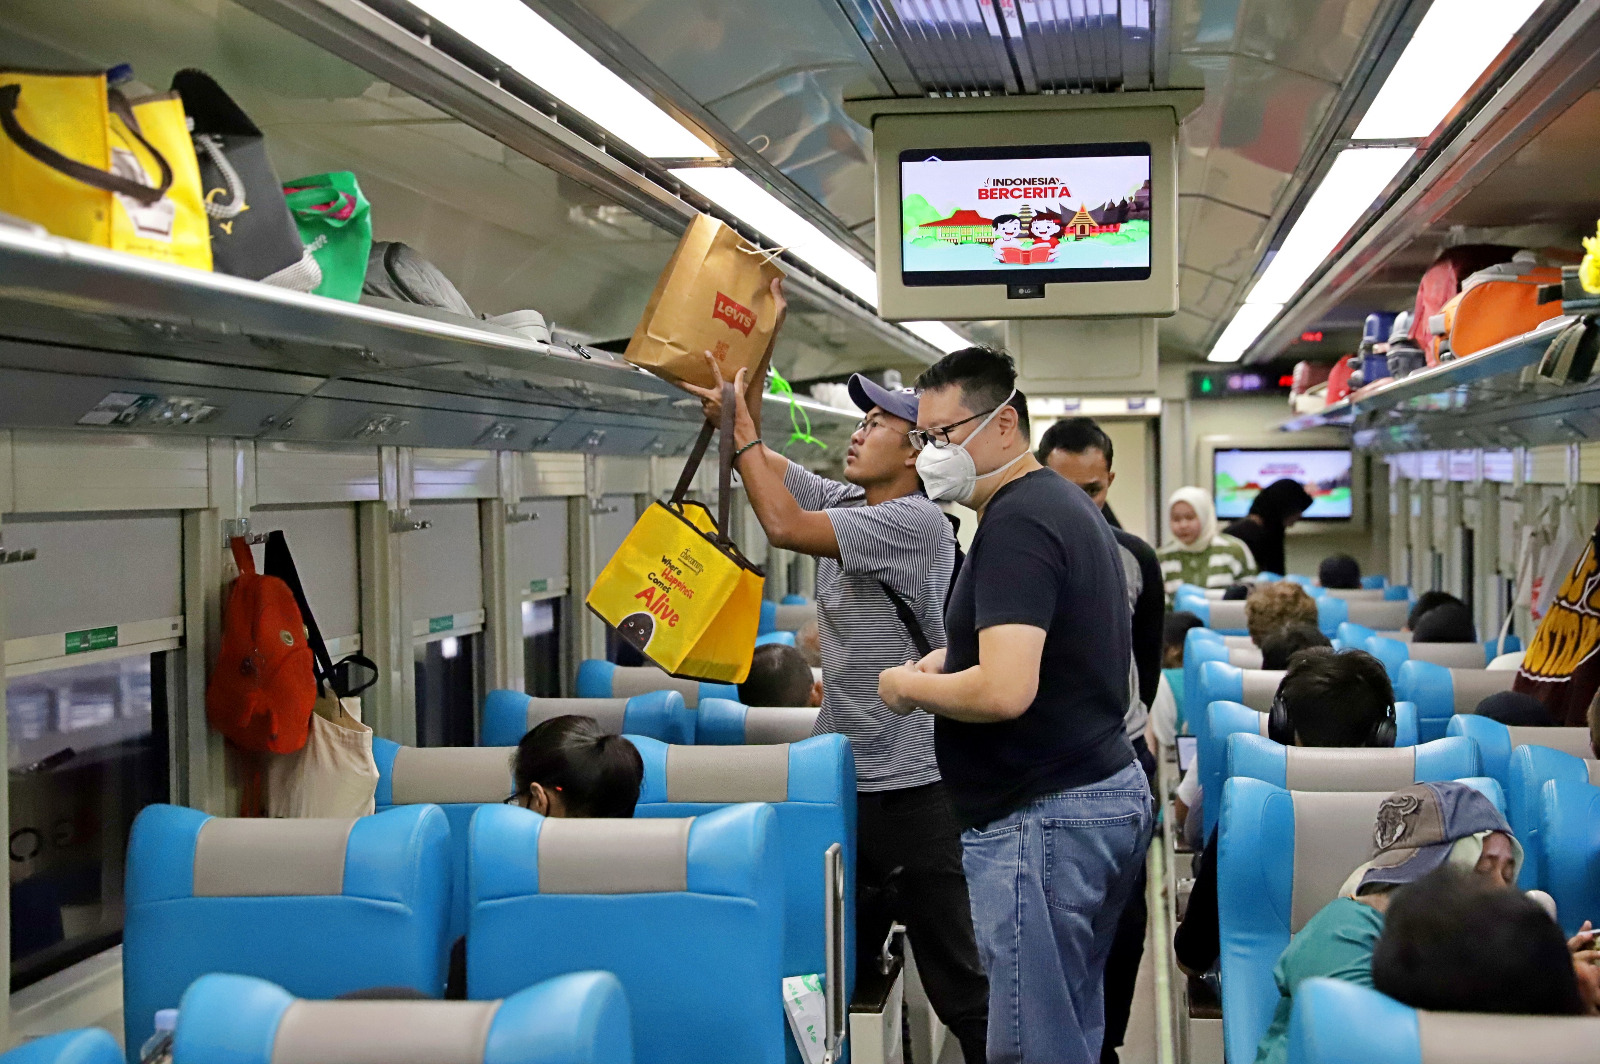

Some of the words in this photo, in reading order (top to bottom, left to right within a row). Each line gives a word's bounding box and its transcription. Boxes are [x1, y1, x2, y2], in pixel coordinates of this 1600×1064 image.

[993, 177, 1057, 186] INDONESIA
[978, 186, 1071, 200] BERCERITA
[661, 554, 683, 576] Where
[647, 572, 672, 594] Comes
[661, 567, 695, 600] Happiness
[635, 586, 680, 627] Alive
